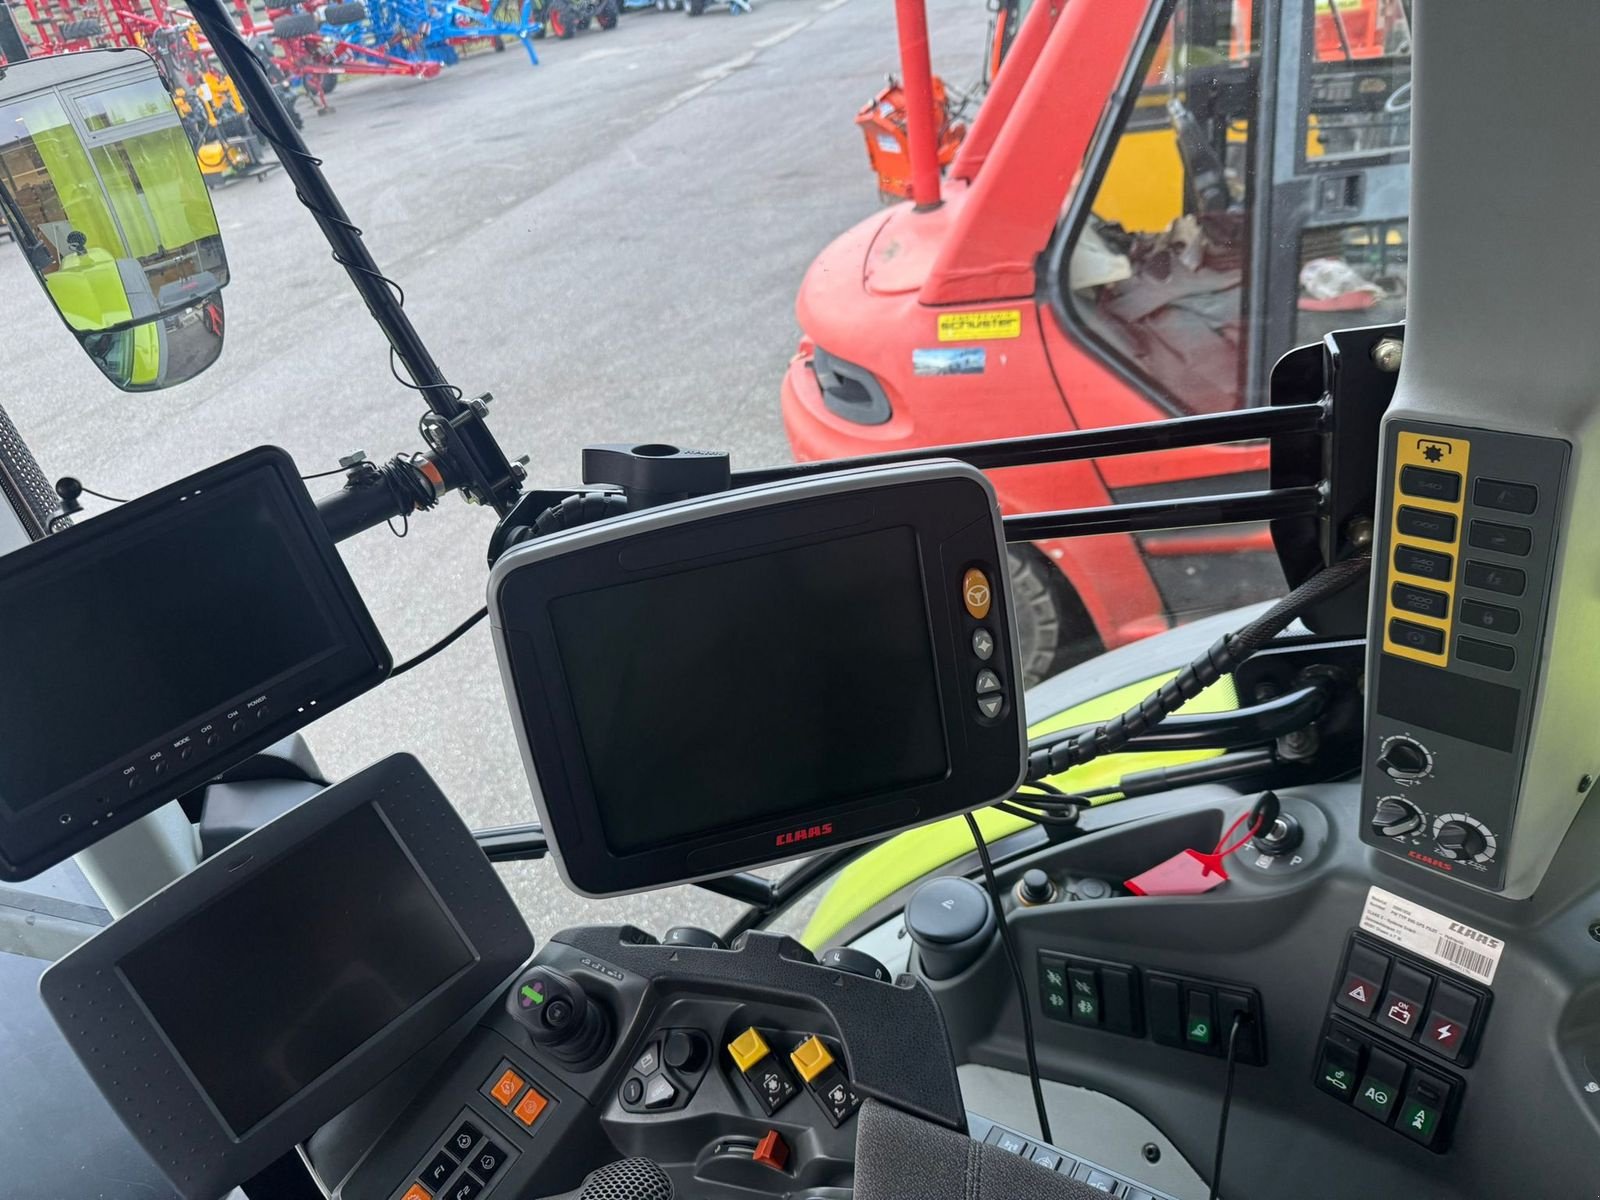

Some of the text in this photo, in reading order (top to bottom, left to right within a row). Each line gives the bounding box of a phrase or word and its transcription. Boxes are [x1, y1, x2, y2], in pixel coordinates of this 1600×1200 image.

[247, 695, 267, 708] POWER
[227, 710, 239, 719] CH4
[173, 736, 191, 748] MODE
[150, 751, 162, 761] CH2
[123, 766, 136, 775] CH1
[776, 823, 832, 846] CLAAS
[1408, 851, 1453, 870] CLAAS
[1448, 922, 1500, 949] CLAAS
[1398, 1001, 1409, 1010] ON
[434, 1165, 445, 1179] F1
[457, 1185, 471, 1200] F2
